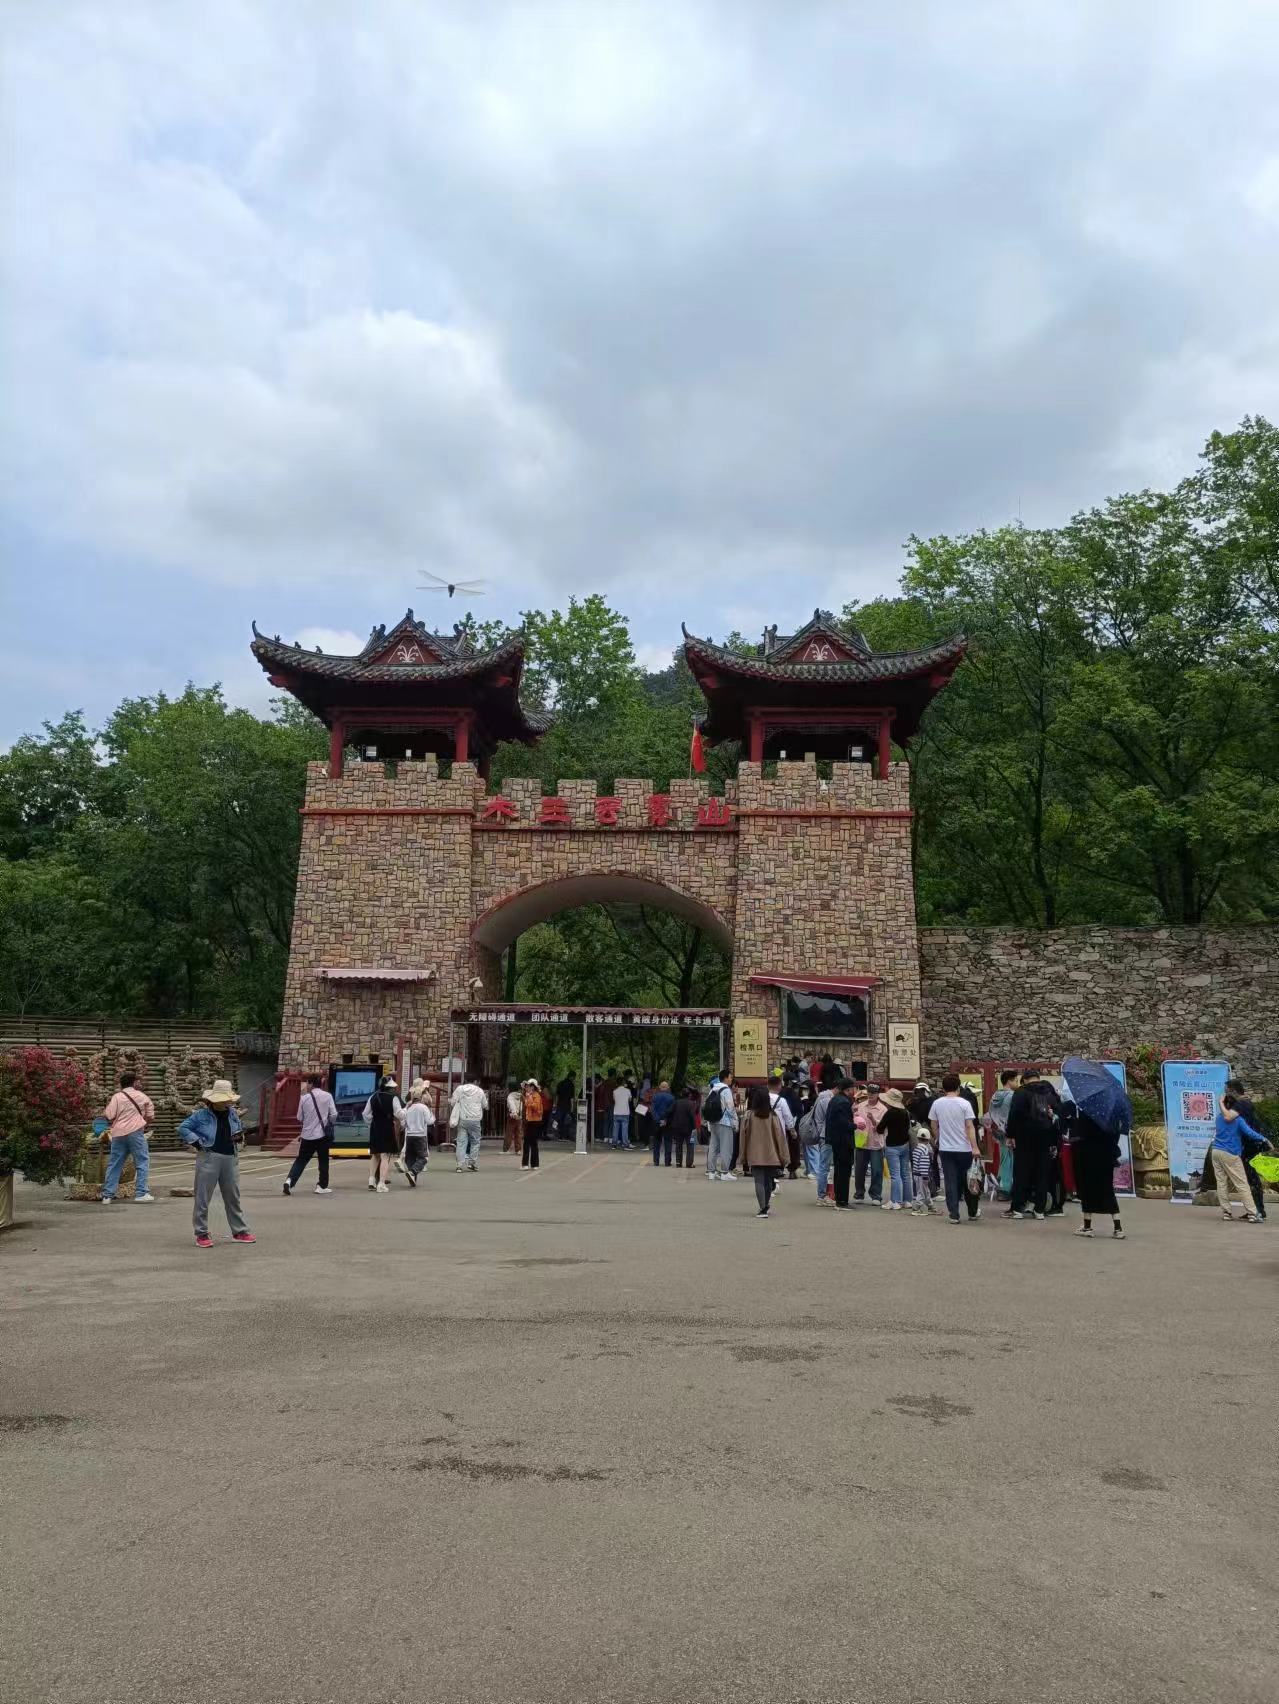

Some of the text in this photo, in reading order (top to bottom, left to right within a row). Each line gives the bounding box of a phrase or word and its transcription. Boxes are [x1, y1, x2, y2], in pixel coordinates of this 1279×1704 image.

[468, 1012, 516, 1022] 无障碍通道
[531, 1013, 569, 1023] 团队通道
[585, 1013, 623, 1023] 散客通道
[632, 1015, 721, 1026] 黄陂身份证 年卡通道
[740, 1043, 763, 1052] 检票口
